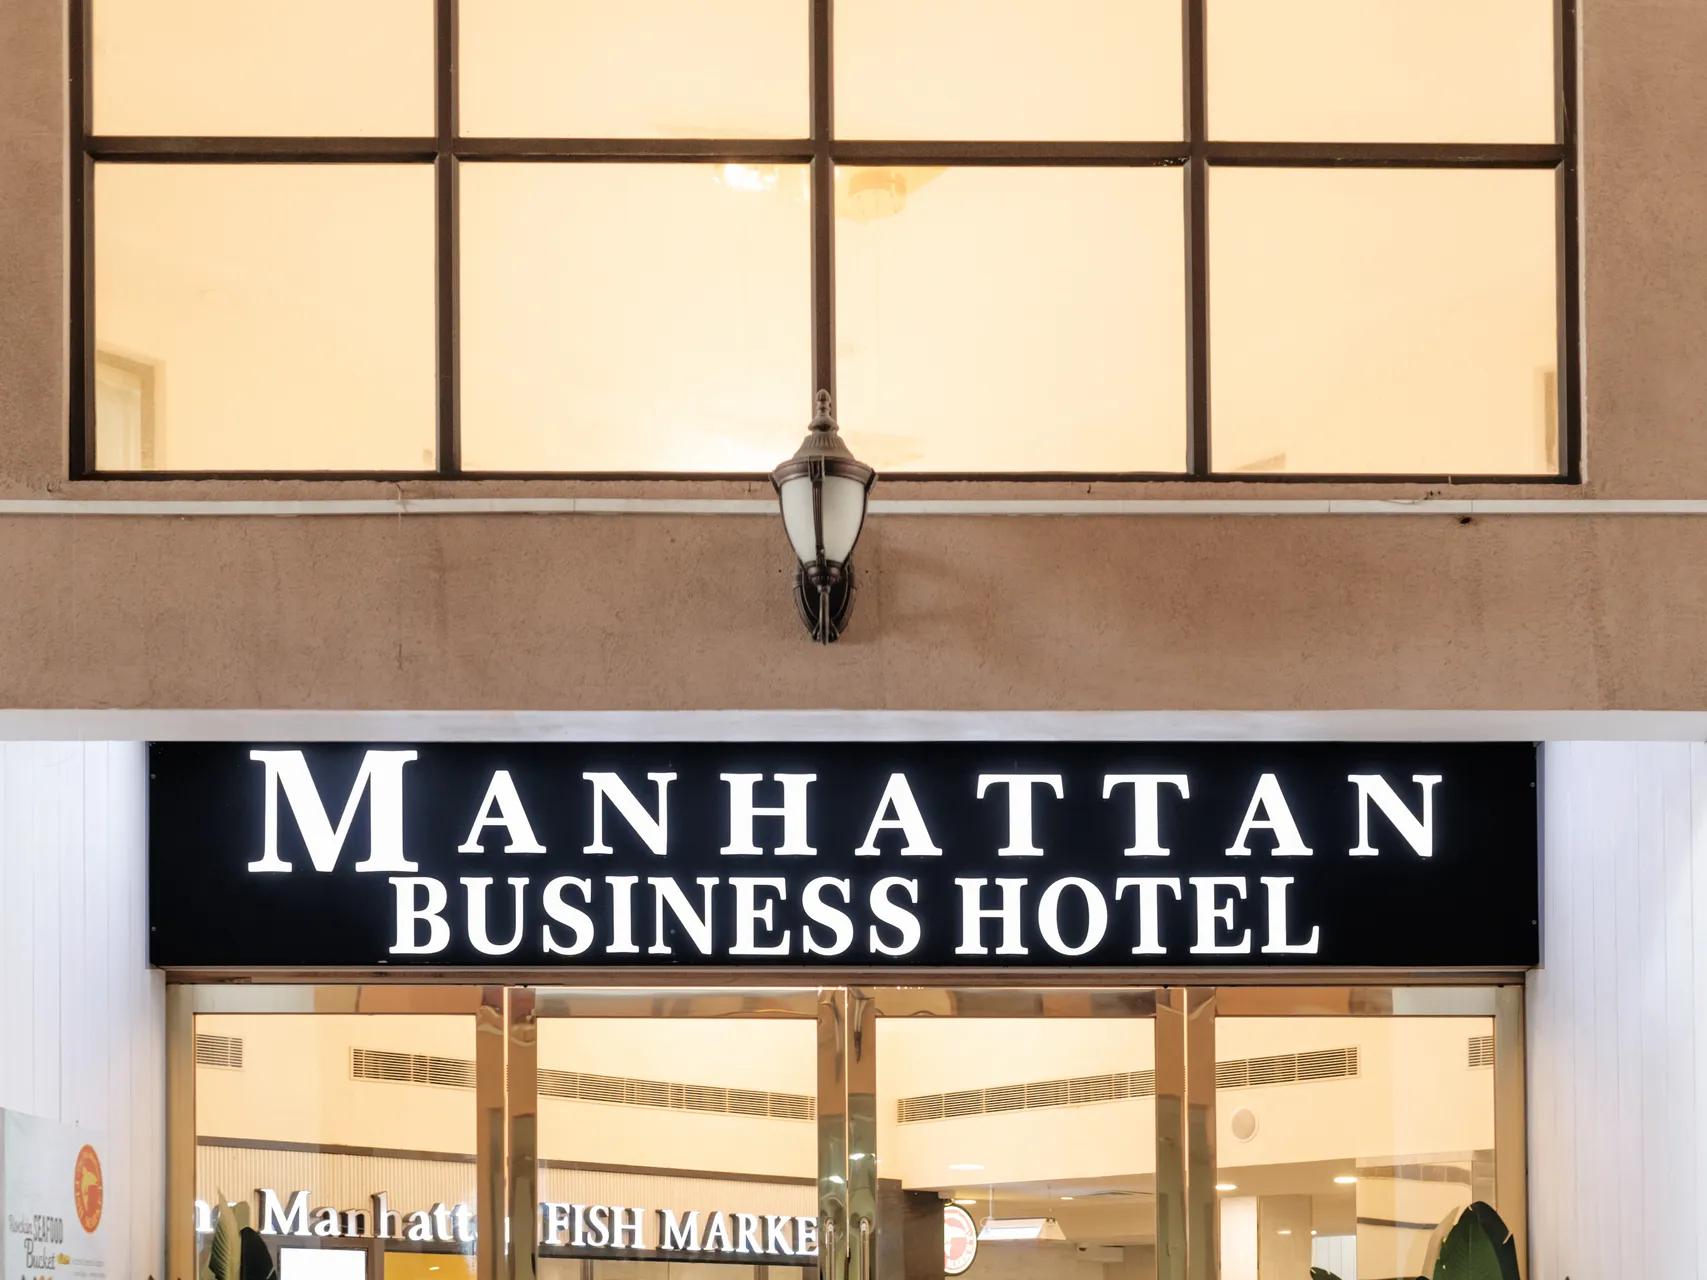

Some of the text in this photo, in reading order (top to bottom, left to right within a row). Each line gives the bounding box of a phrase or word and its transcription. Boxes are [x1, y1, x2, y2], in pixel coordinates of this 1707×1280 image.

[247, 749, 1443, 873] MANHATTAN
[388, 876, 1320, 956] BUSINESS HOTEL
[24, 1237, 55, 1270] Bucket
[33, 1214, 63, 1244] SEAFOOD
[258, 1187, 480, 1242] Manhatt
[541, 1201, 645, 1249] FISH
[656, 1209, 819, 1256] MARKE
